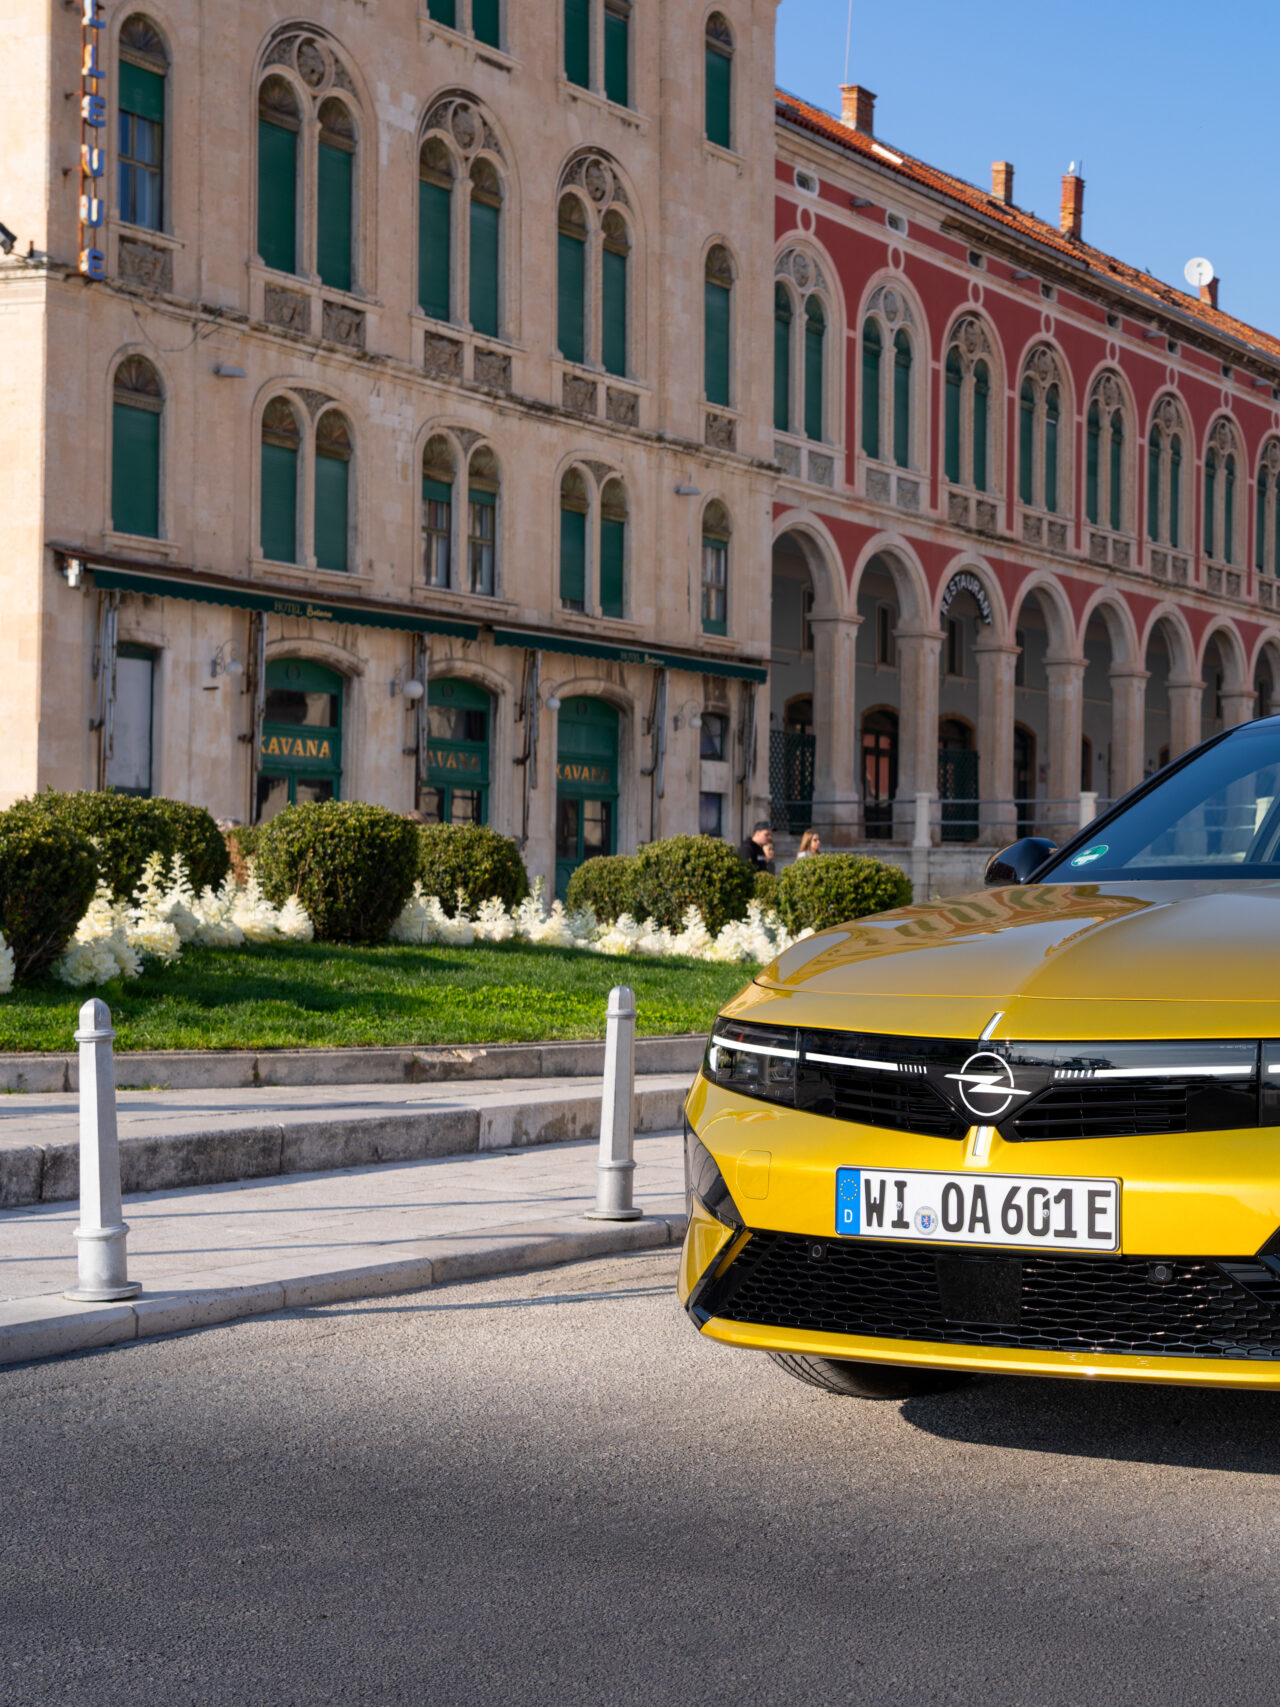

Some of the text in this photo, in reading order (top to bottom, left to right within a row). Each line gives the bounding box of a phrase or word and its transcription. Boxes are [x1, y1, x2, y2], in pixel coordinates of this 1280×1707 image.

[426, 751, 481, 772] AVANA
[864, 1178, 910, 1230] WI
[843, 1209, 854, 1223] D
